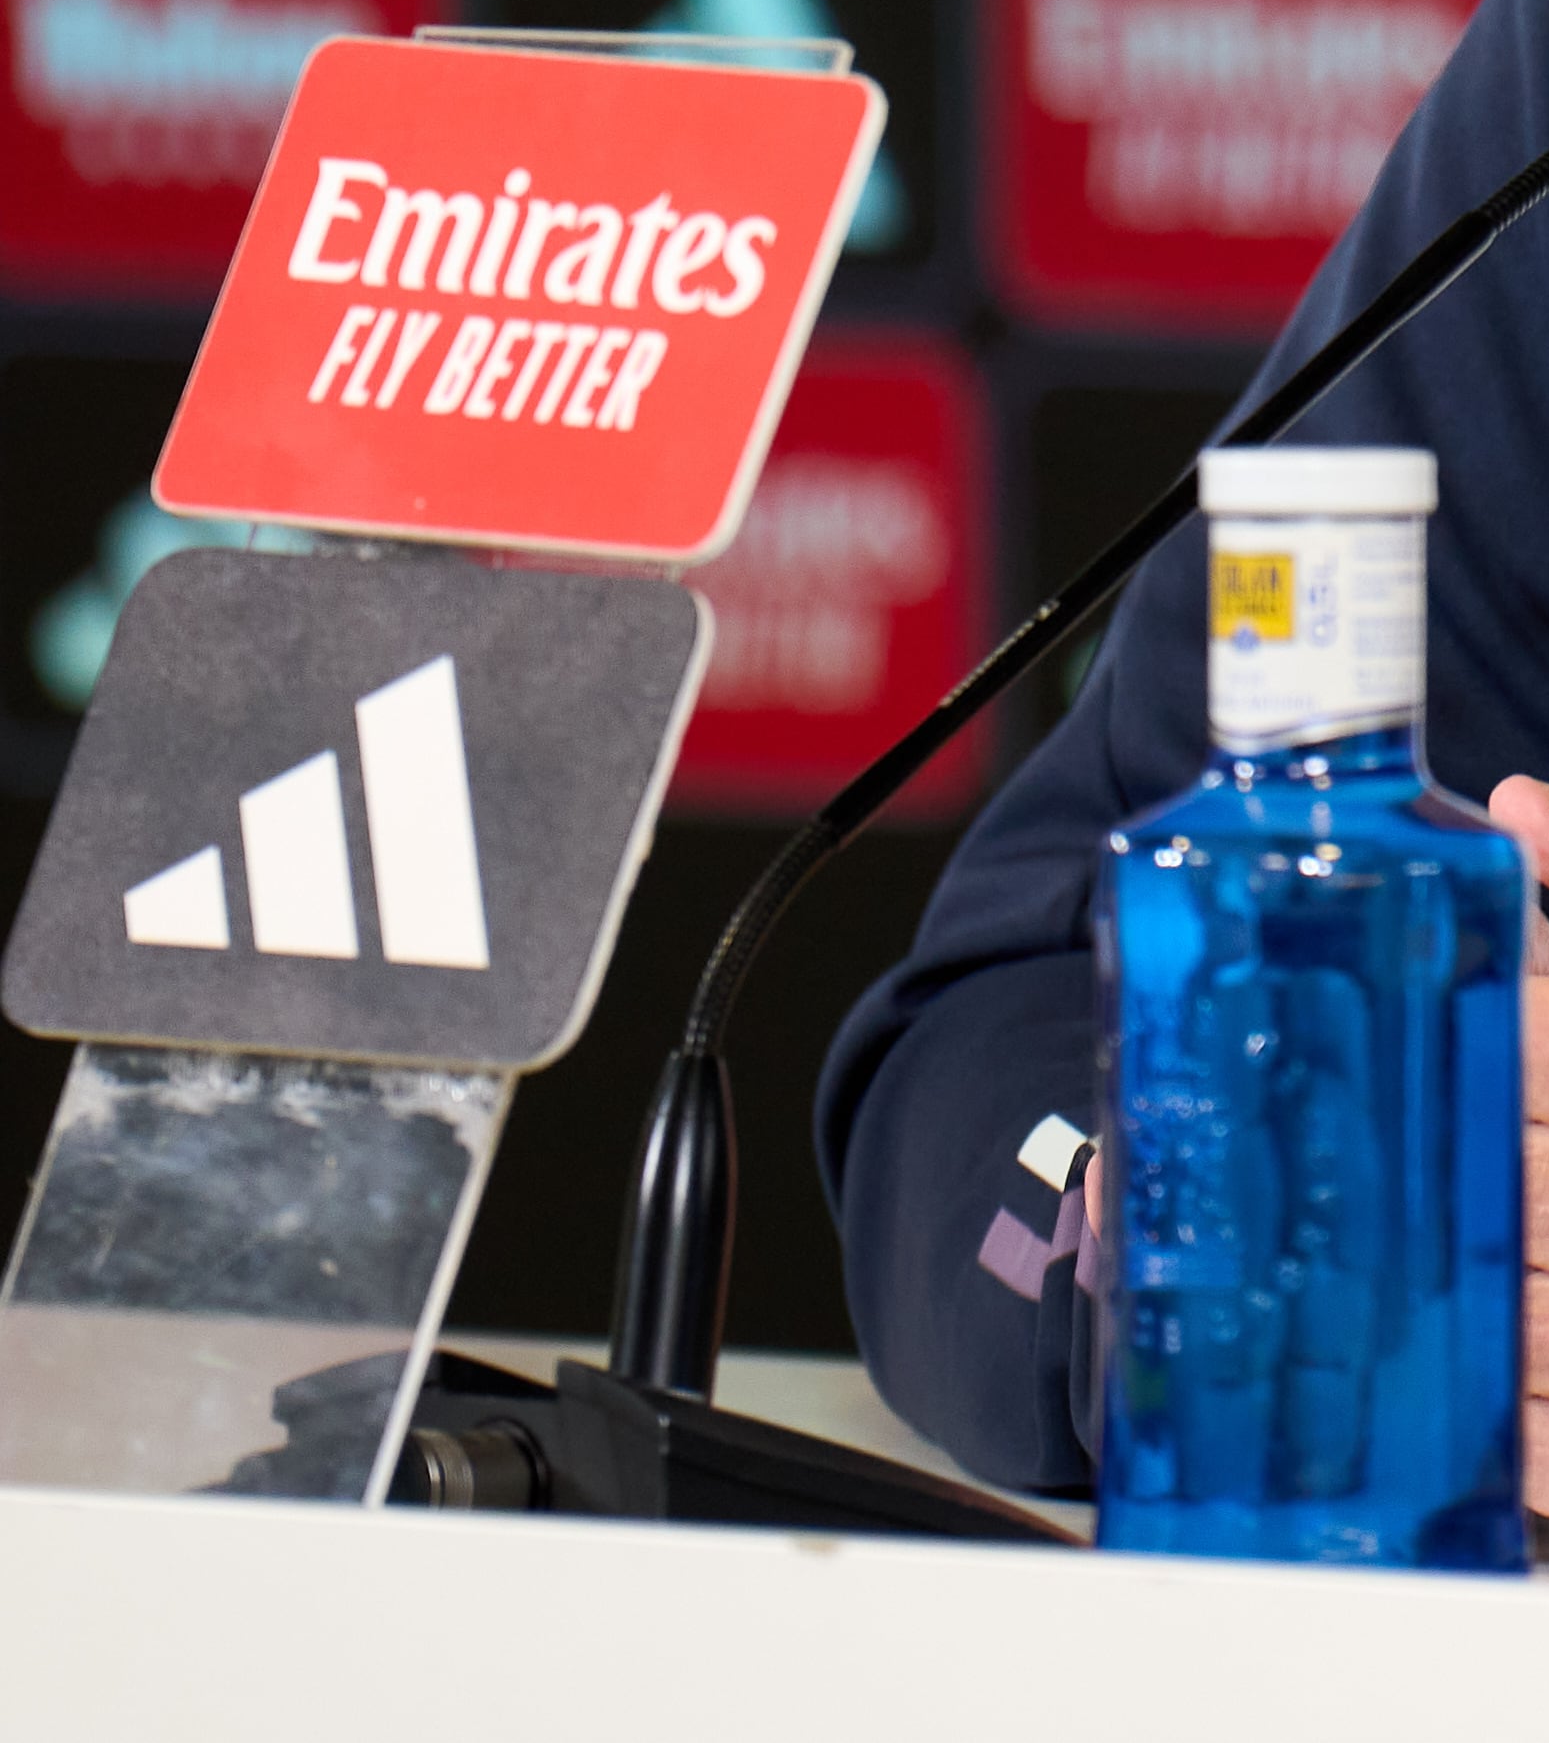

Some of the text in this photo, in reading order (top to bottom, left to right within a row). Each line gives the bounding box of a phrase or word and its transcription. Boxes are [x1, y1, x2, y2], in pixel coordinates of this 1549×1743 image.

[288, 157, 777, 319] Emirates
[307, 304, 669, 431] FLY BETTER
